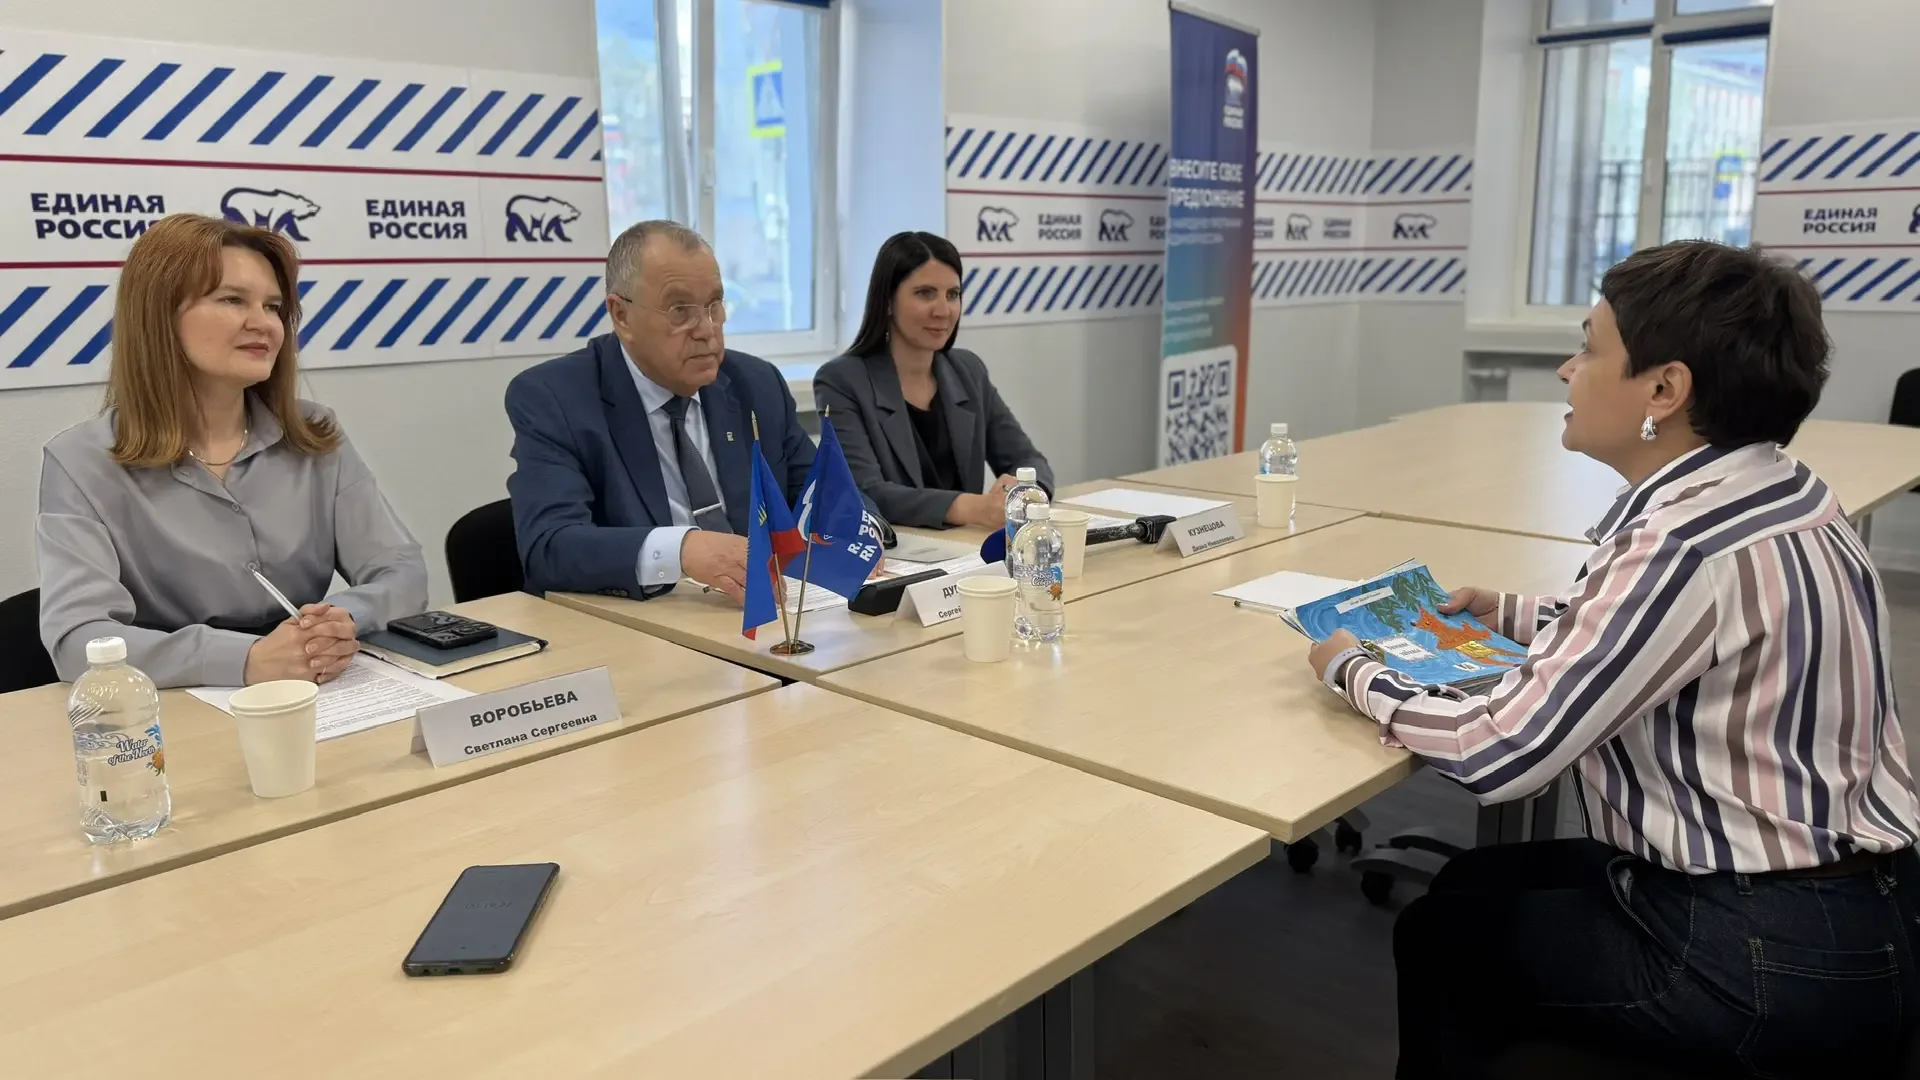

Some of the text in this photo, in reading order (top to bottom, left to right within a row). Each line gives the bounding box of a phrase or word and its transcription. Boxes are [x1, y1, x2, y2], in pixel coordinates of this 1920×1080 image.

[30, 192, 165, 215] ЕДИНАЯ
[365, 199, 465, 219] ЕДИНАЯ
[1038, 213, 1082, 226] ЕДИНАЯ
[1804, 207, 1878, 221] ЕДИНАЯ
[35, 219, 159, 239] РОССИ
[368, 221, 468, 240] РОССИЯ
[1038, 228, 1082, 241] РОССИЯ
[1803, 221, 1876, 234] РОССИЯ
[1187, 519, 1226, 537] КУЗНЕЦОВА
[469, 690, 579, 728] ВОРОБЬЕВА
[464, 714, 598, 755] Светлана Сергеевна
[116, 738, 149, 753] Water
[107, 754, 120, 767] of
